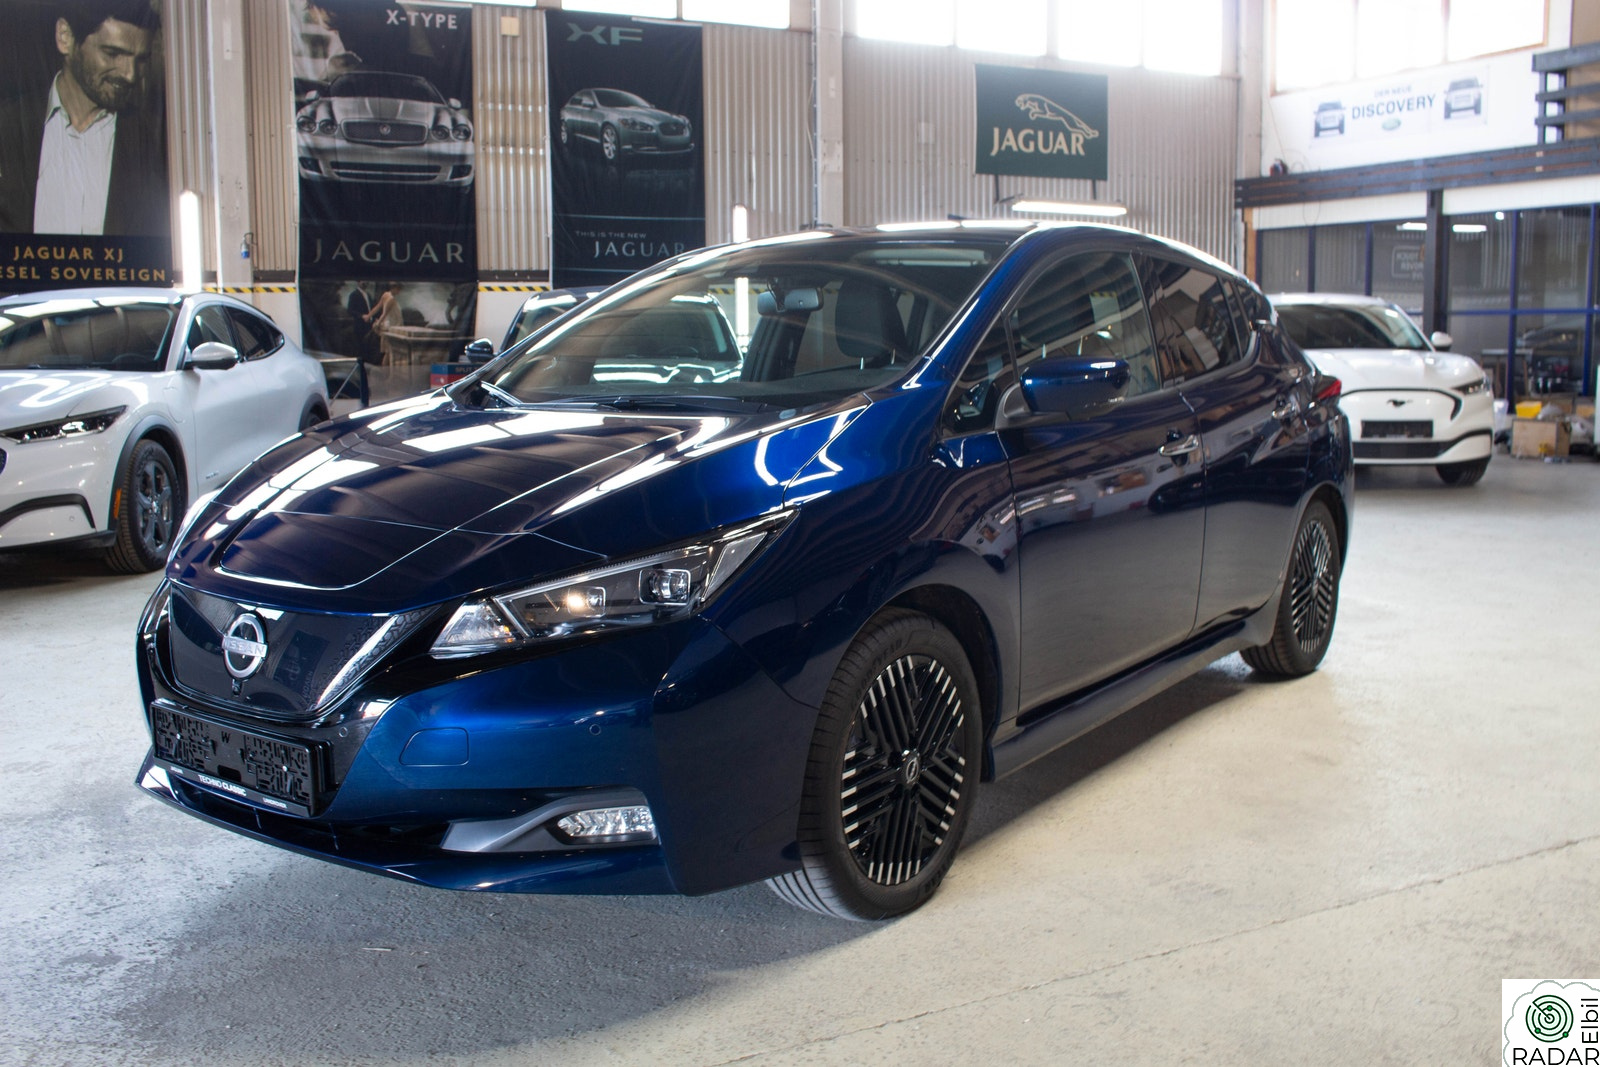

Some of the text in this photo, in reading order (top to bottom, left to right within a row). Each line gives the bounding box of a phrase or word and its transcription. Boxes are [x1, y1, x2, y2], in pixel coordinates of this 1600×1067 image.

[386, 9, 457, 30] X-TYPE
[566, 22, 643, 45] XF
[1352, 94, 1436, 119] DISCOVERY
[990, 127, 1085, 156] JAGUAR
[575, 230, 596, 238] THIS
[13, 246, 123, 263] JAGUAR XJ
[313, 238, 464, 264] JAGUAR
[50, 266, 166, 281] SOVEREIGN
